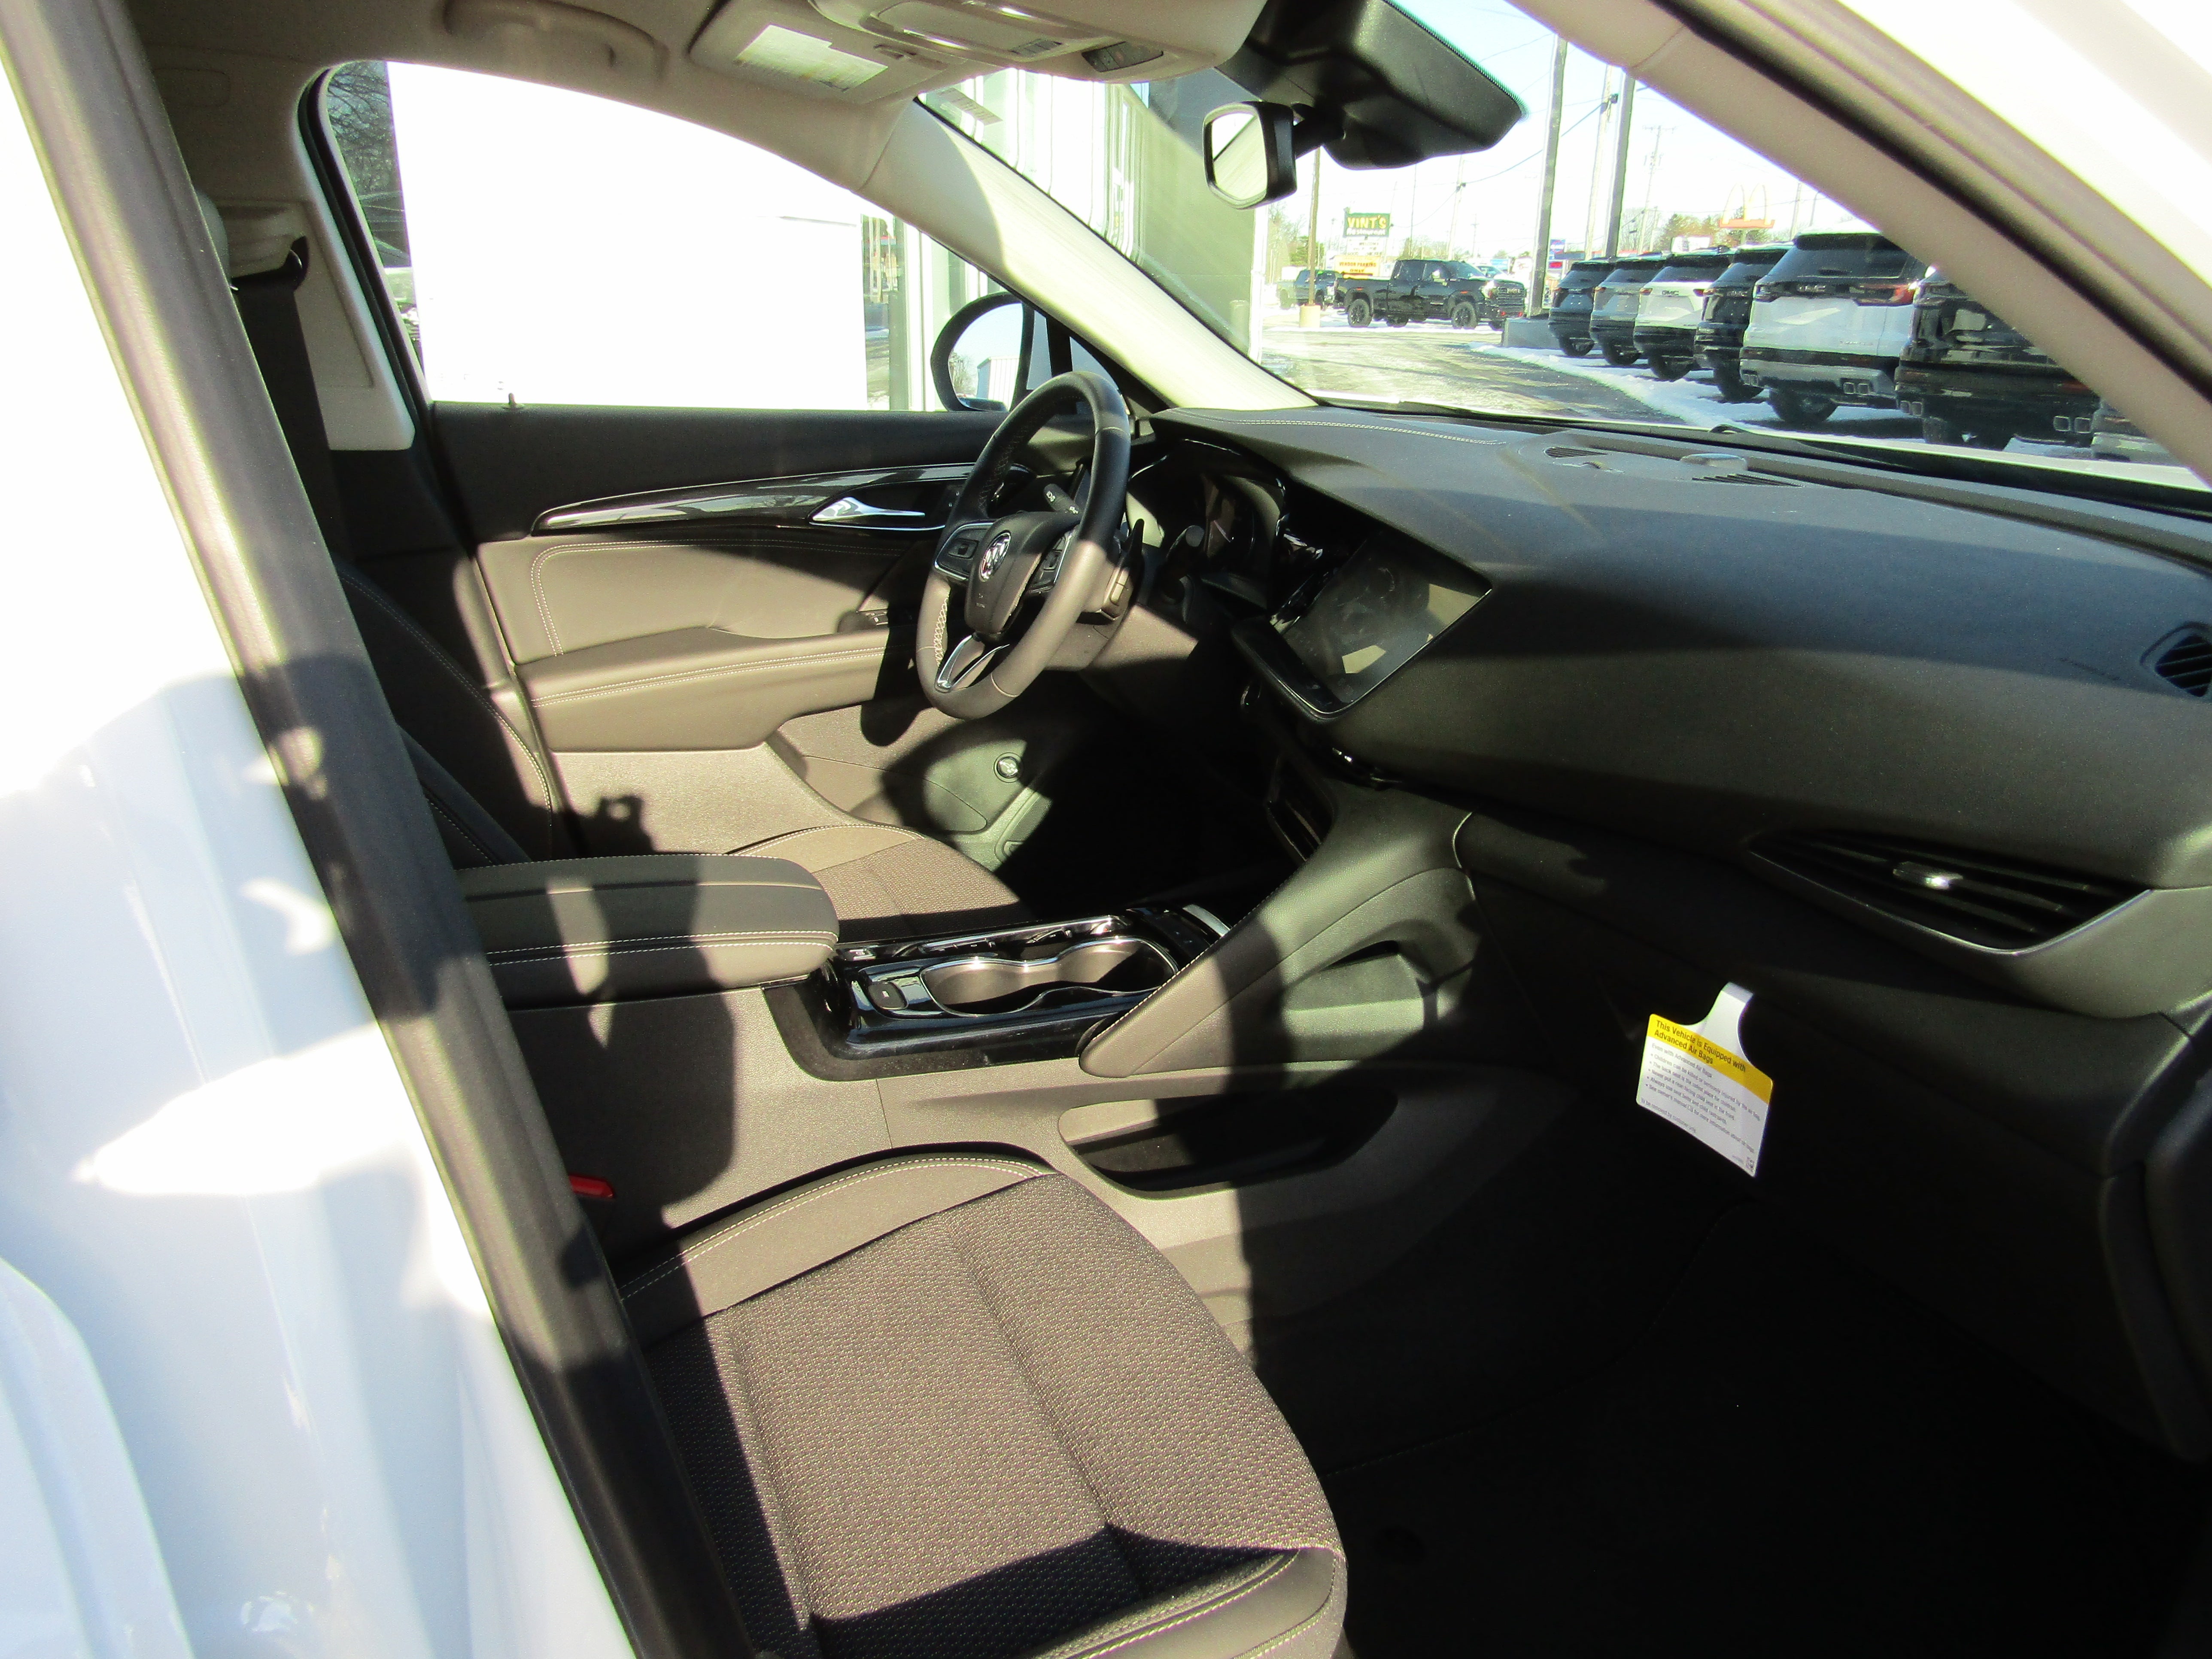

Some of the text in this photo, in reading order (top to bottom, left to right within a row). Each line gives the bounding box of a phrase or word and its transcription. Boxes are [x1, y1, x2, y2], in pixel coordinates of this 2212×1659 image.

[1347, 215, 1387, 229] VINT'S
[1652, 1042, 1662, 1051] Even
[1675, 1053, 1695, 1067] Advanced
[1654, 1029, 1713, 1064] Advanced Air Bags
[1656, 1020, 1746, 1073] This Vehicle is Equipped with
[1654, 1054, 1672, 1066] Children
